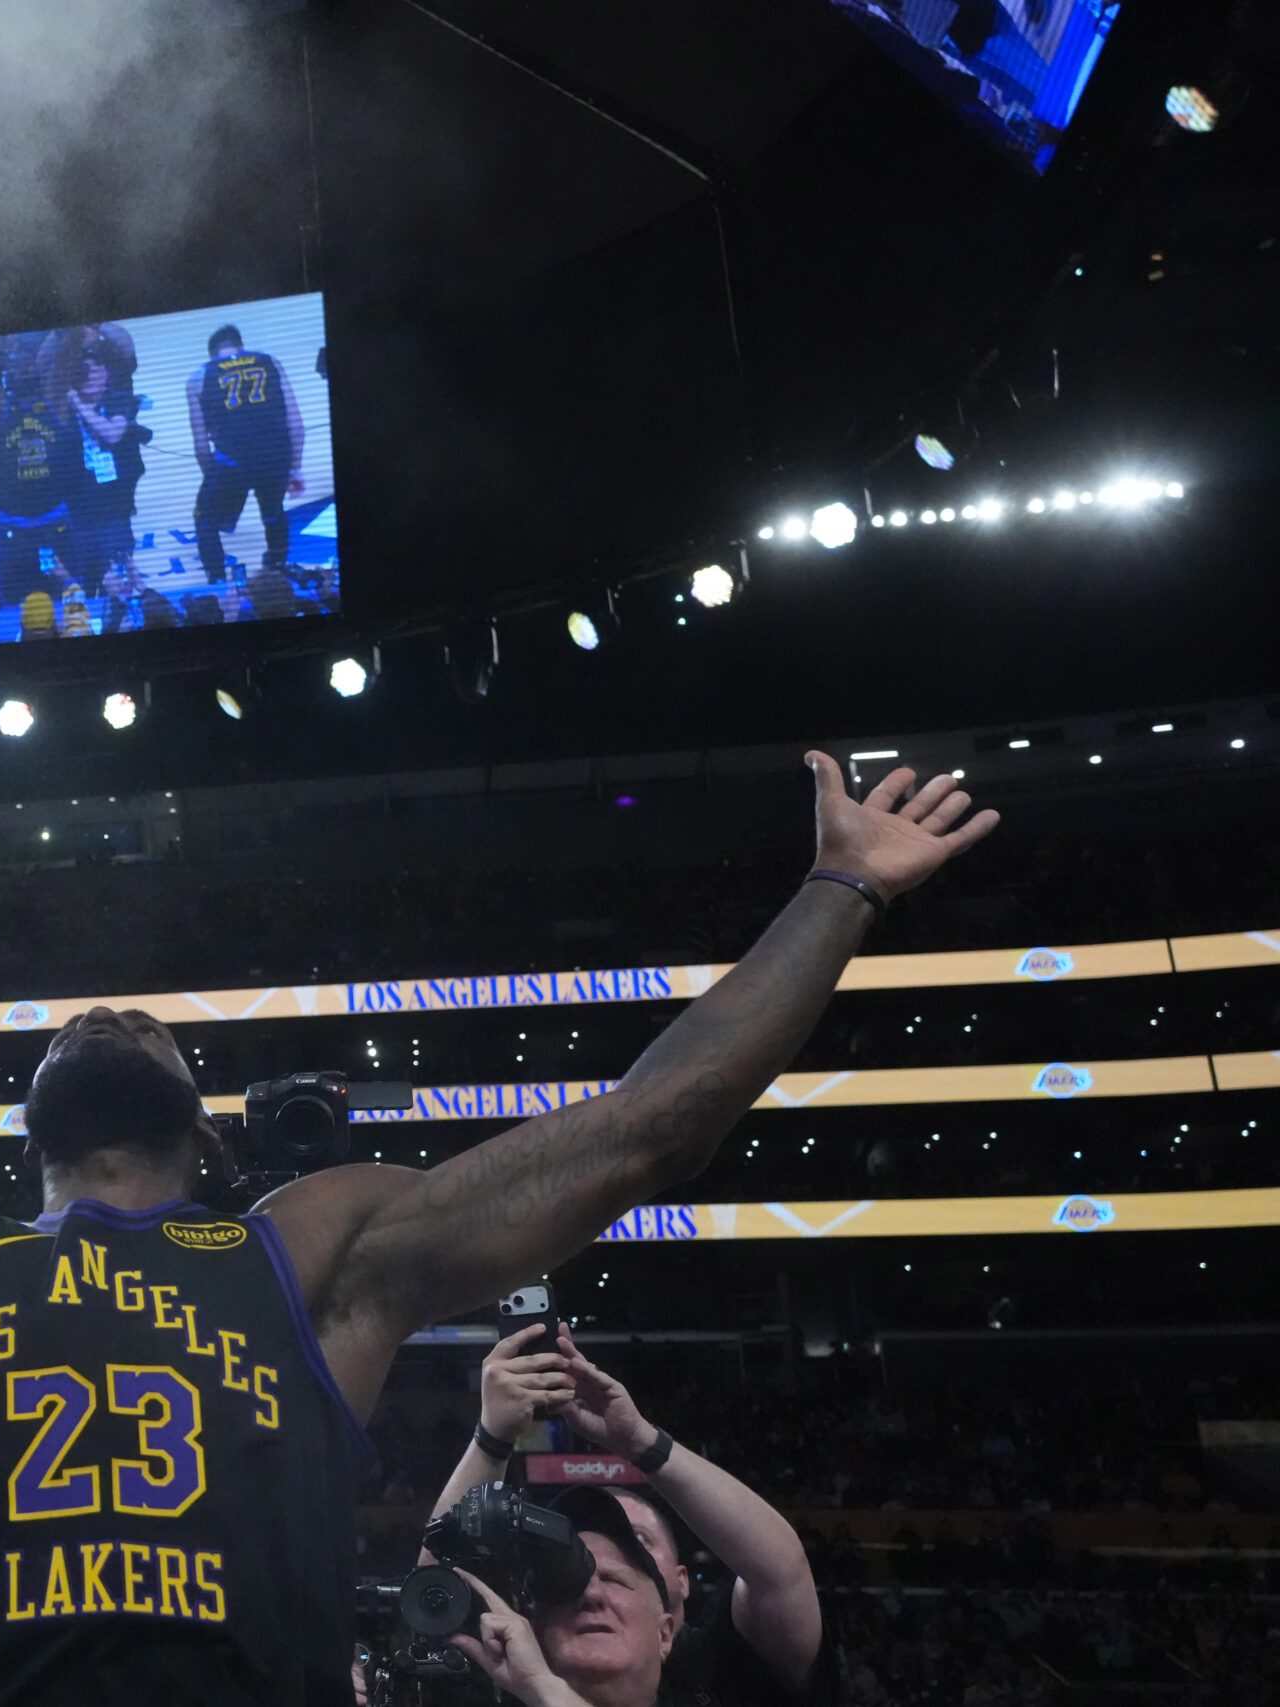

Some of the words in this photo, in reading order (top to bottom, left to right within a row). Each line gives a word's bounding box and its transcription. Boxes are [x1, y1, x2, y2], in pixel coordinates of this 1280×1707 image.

[218, 367, 267, 409] 77
[346, 980, 404, 1013] LOS
[410, 972, 546, 1011] ANGELES
[550, 967, 673, 1006] LAKERS
[412, 1083, 553, 1120] ANGELES
[169, 1226, 241, 1242] bibigo
[48, 1239, 279, 1429] ANGELES
[6, 1363, 207, 1522] 23
[6, 1542, 226, 1622] LAKERS
